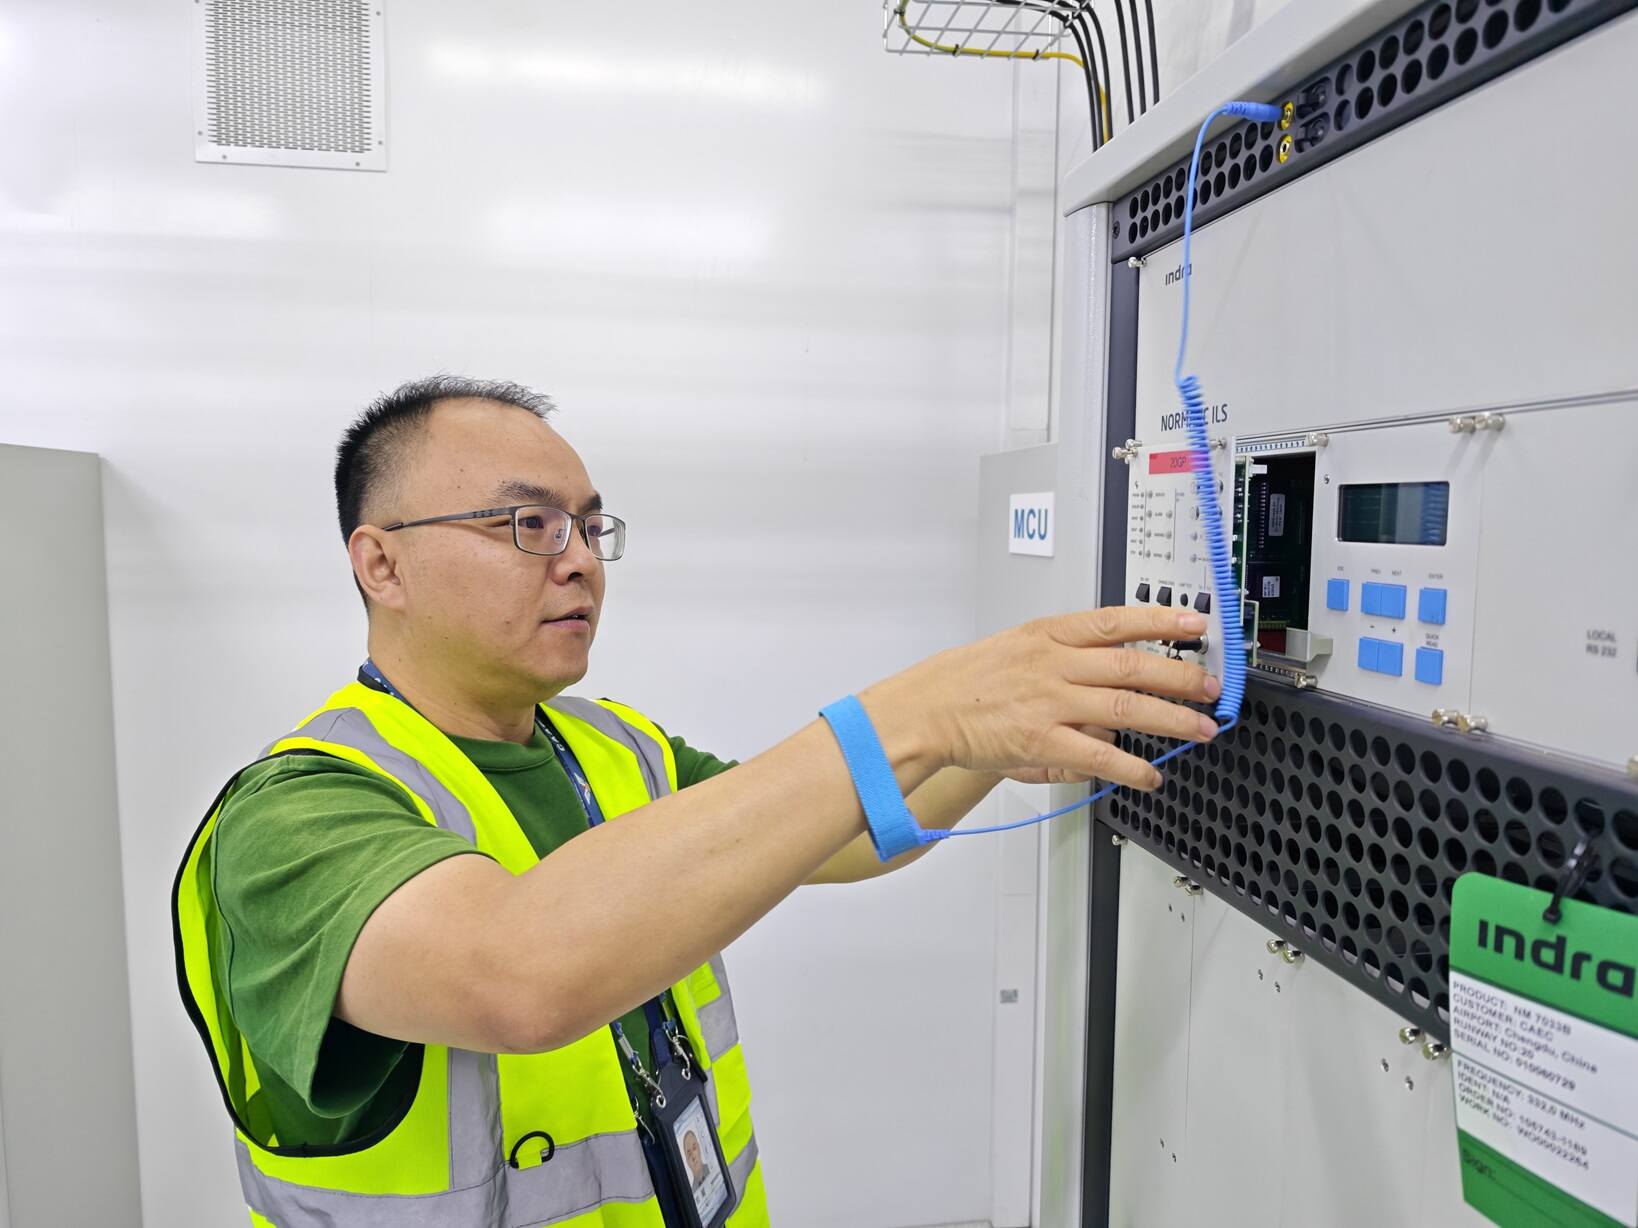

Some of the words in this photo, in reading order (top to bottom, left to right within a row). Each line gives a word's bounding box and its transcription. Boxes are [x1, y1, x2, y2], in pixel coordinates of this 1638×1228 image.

[1161, 407, 1209, 433] NORMC
[1211, 403, 1228, 424] ILS
[1014, 508, 1048, 540] MCU
[1478, 918, 1636, 999] indra
[1453, 981, 1507, 1009] PRODUCT:
[1514, 1005, 1531, 1019] NM
[1453, 993, 1516, 1024] CUSTOMER:
[1453, 1017, 1497, 1043] RUNWAY
[1453, 1006, 1501, 1031] AIRPORT:
[1505, 1028, 1559, 1058] Chengdu,
[1562, 1051, 1597, 1074] China
[1454, 1028, 1491, 1053] SERIAL
[1457, 1059, 1524, 1100] FREQUENCY:
[1458, 1082, 1494, 1107] ORDER
[1459, 1093, 1491, 1118] WORK
